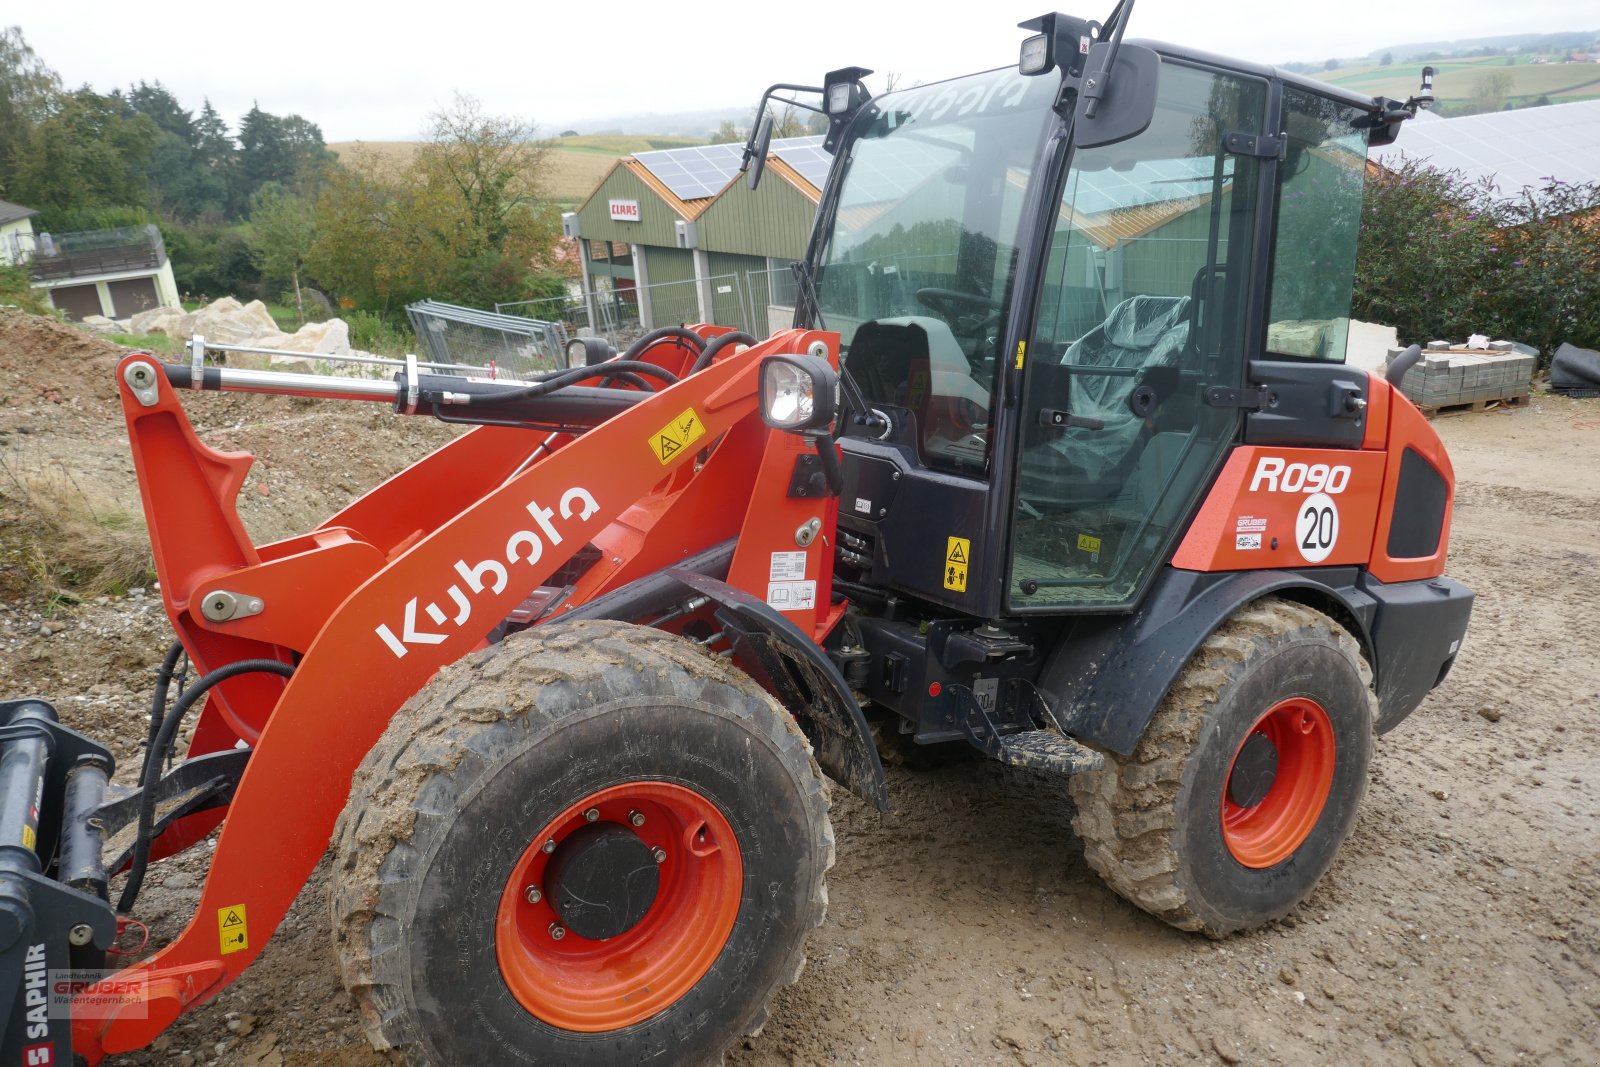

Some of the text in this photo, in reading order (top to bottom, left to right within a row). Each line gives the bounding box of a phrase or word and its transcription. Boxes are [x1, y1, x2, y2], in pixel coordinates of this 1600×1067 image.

[612, 204, 637, 216] CLAAS
[1237, 519, 1267, 527] GRUBER
[1302, 506, 1334, 549] 20
[374, 487, 600, 659] Kubota
[24, 943, 49, 1039] SAPHIR
